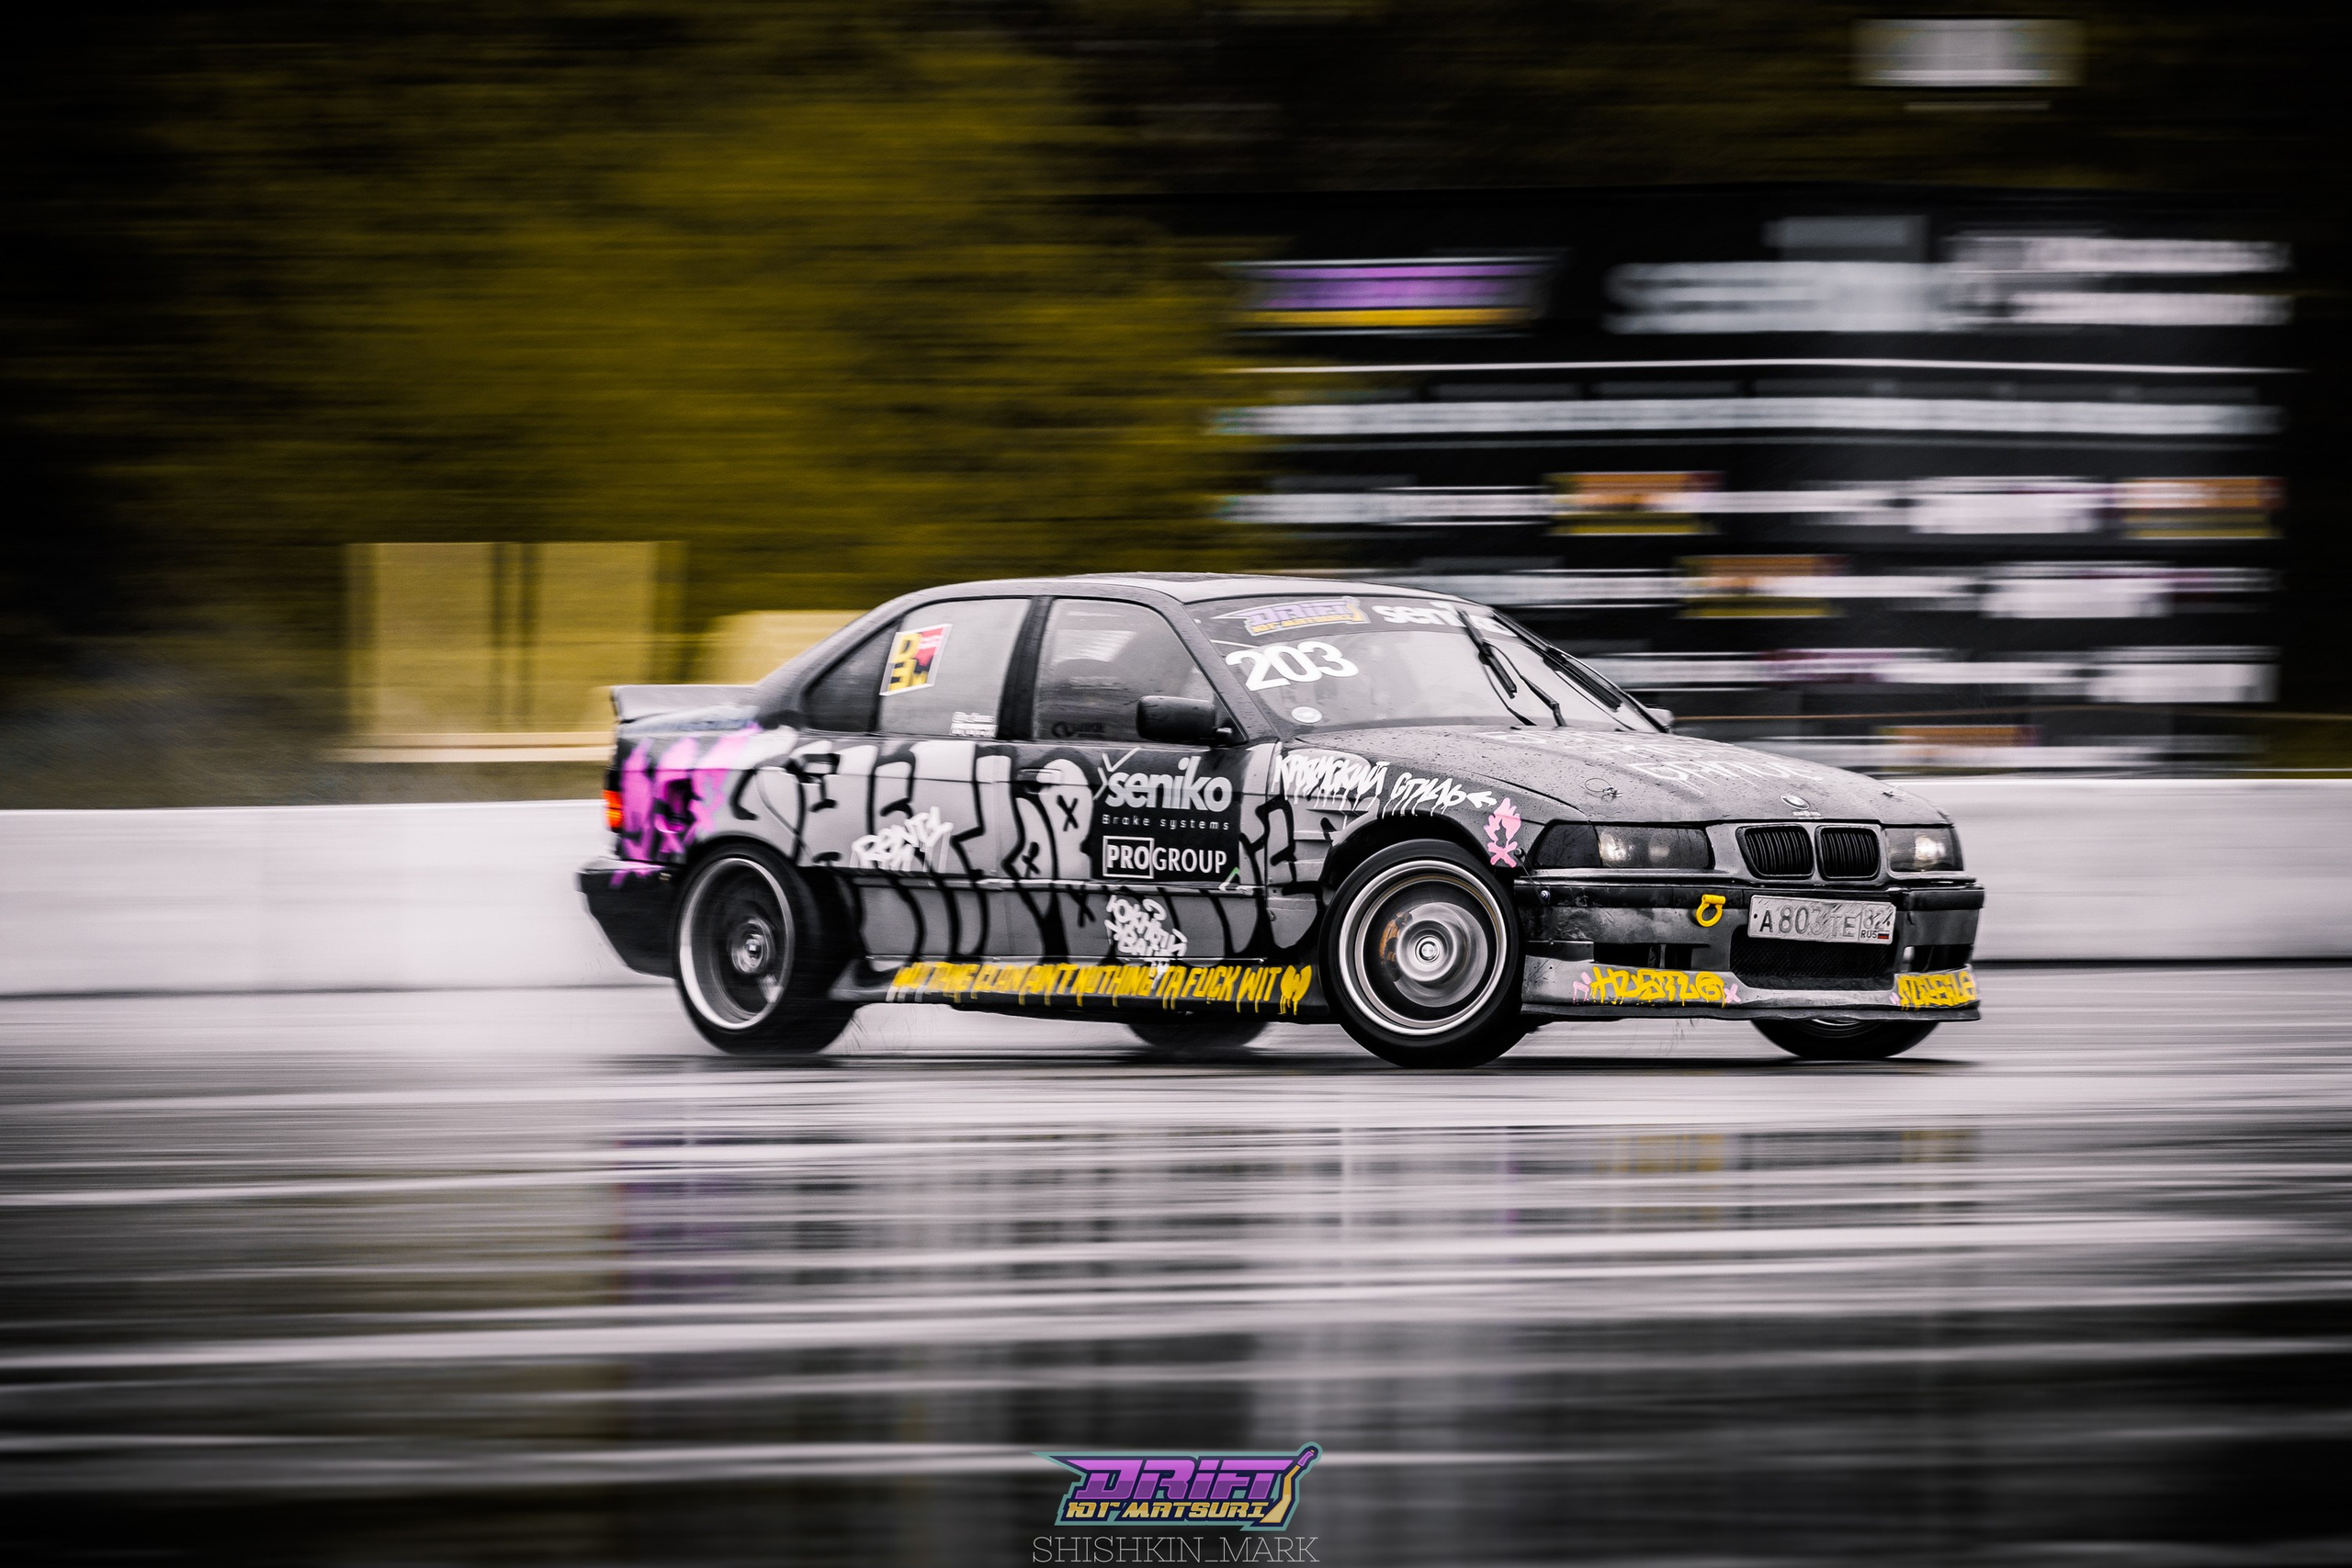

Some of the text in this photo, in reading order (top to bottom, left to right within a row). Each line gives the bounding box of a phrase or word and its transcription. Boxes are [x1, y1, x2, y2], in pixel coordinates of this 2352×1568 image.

[1226, 641, 1359, 691] 203
[1105, 756, 1233, 812] seniko
[1102, 814, 1230, 830] Brake systems
[1860, 930, 1878, 939] RUS
[1156, 965, 1187, 998] TA
[1181, 965, 1242, 1001] FUCK
[1238, 967, 1283, 1001] WIT
